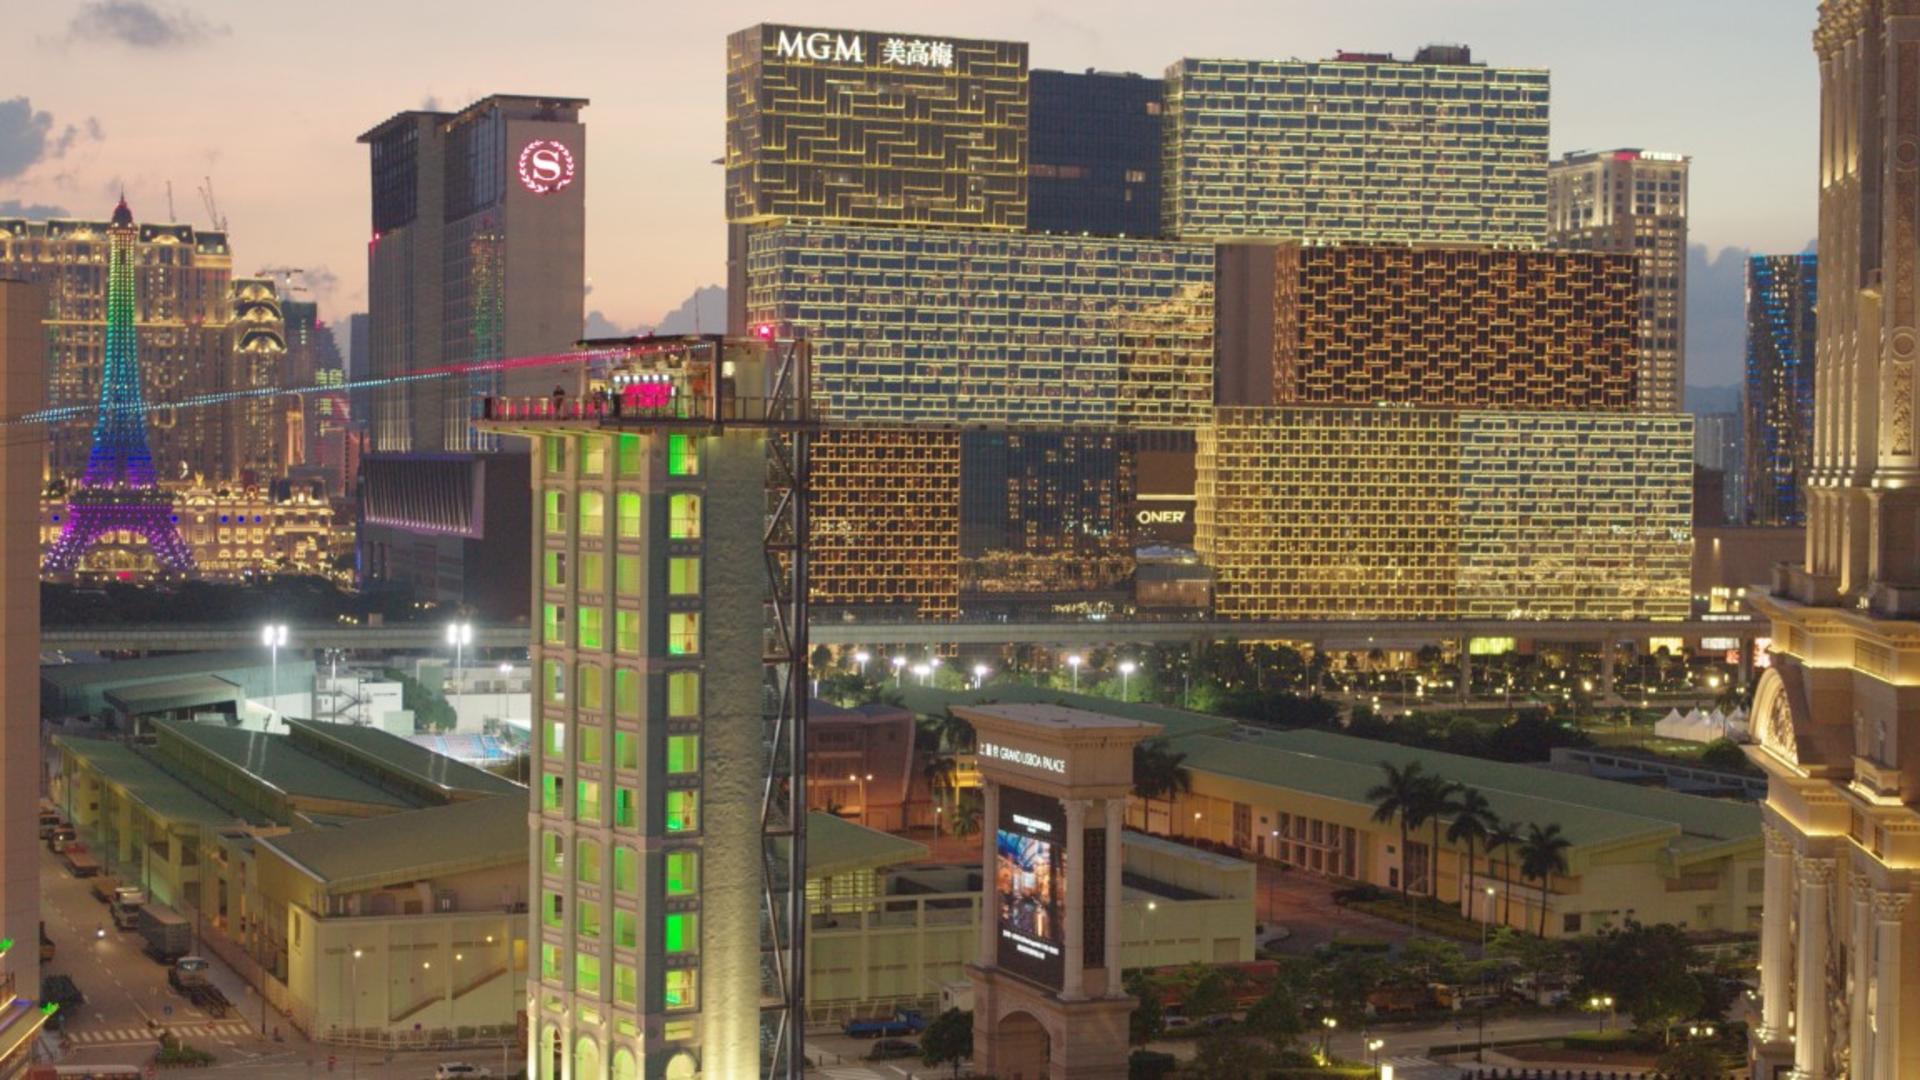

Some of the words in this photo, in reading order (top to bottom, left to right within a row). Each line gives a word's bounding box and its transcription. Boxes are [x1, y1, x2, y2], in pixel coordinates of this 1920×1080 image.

[777, 30, 864, 63] MGM
[882, 38, 953, 68] 美高梅
[533, 149, 561, 181] S
